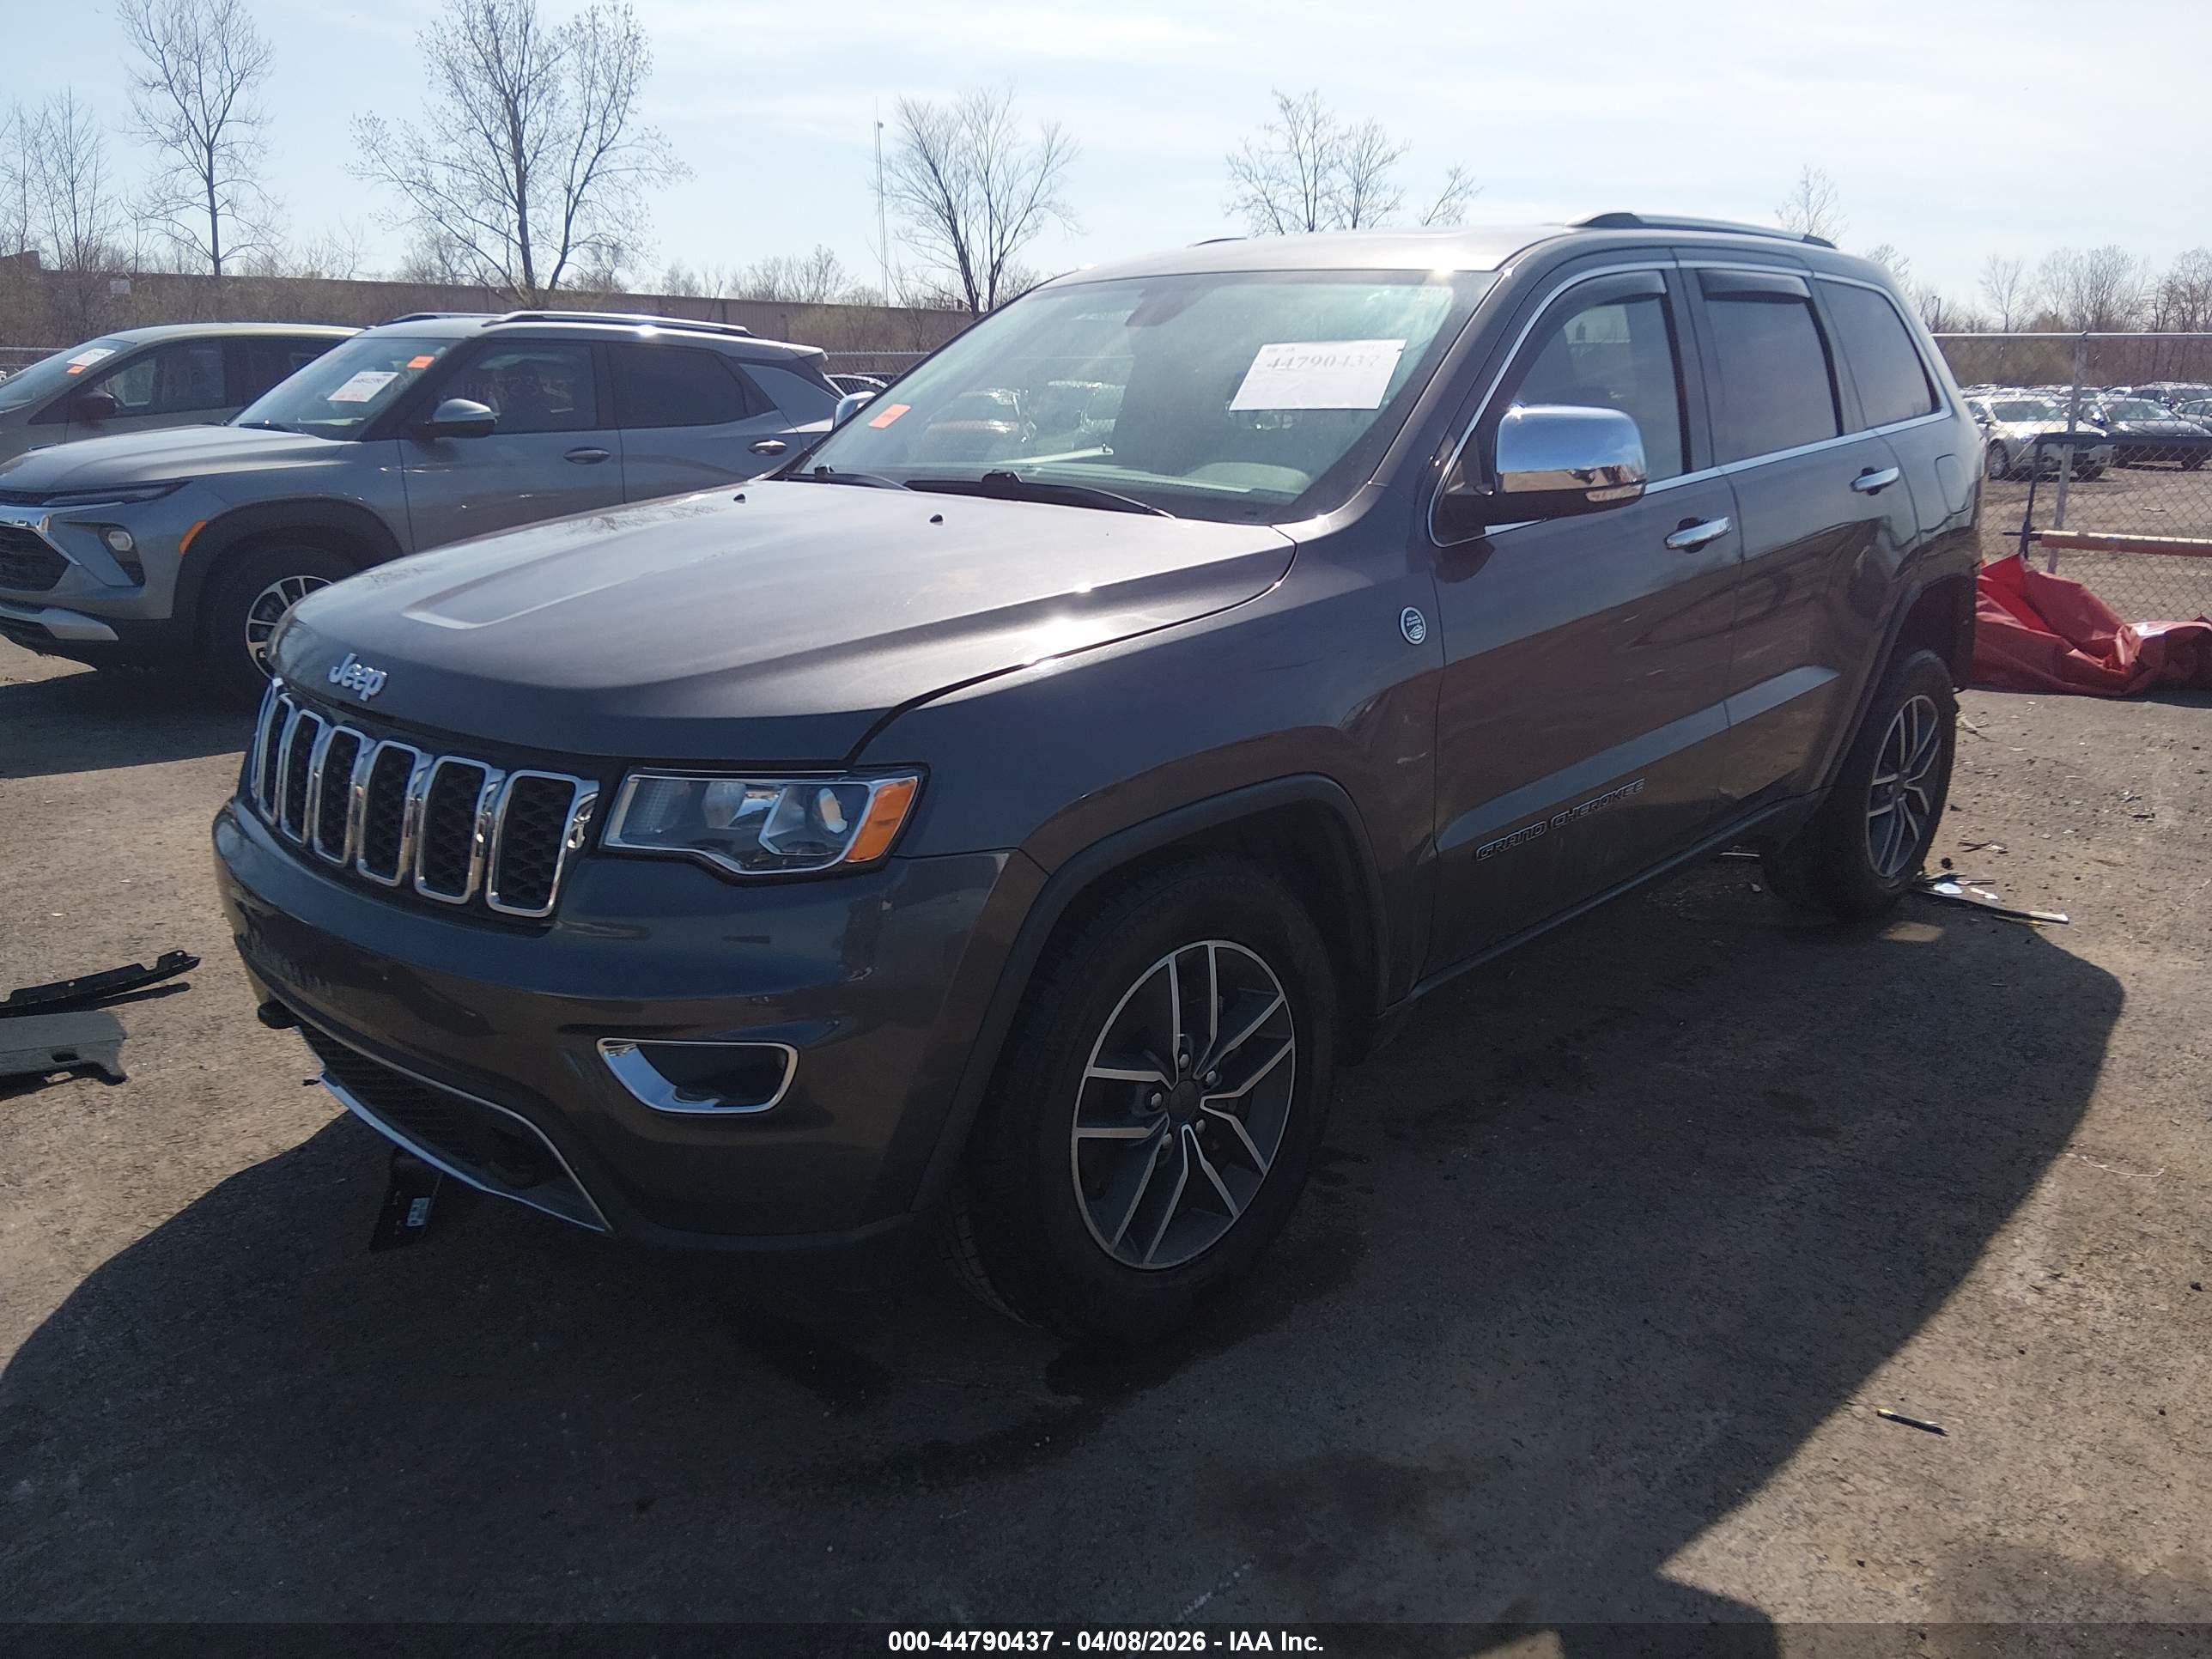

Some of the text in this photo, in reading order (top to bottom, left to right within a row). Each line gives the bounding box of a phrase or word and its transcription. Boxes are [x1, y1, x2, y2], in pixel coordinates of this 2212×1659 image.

[328, 653, 388, 702] Jeep
[1475, 777, 1646, 861] GRAND CHEROKEE
